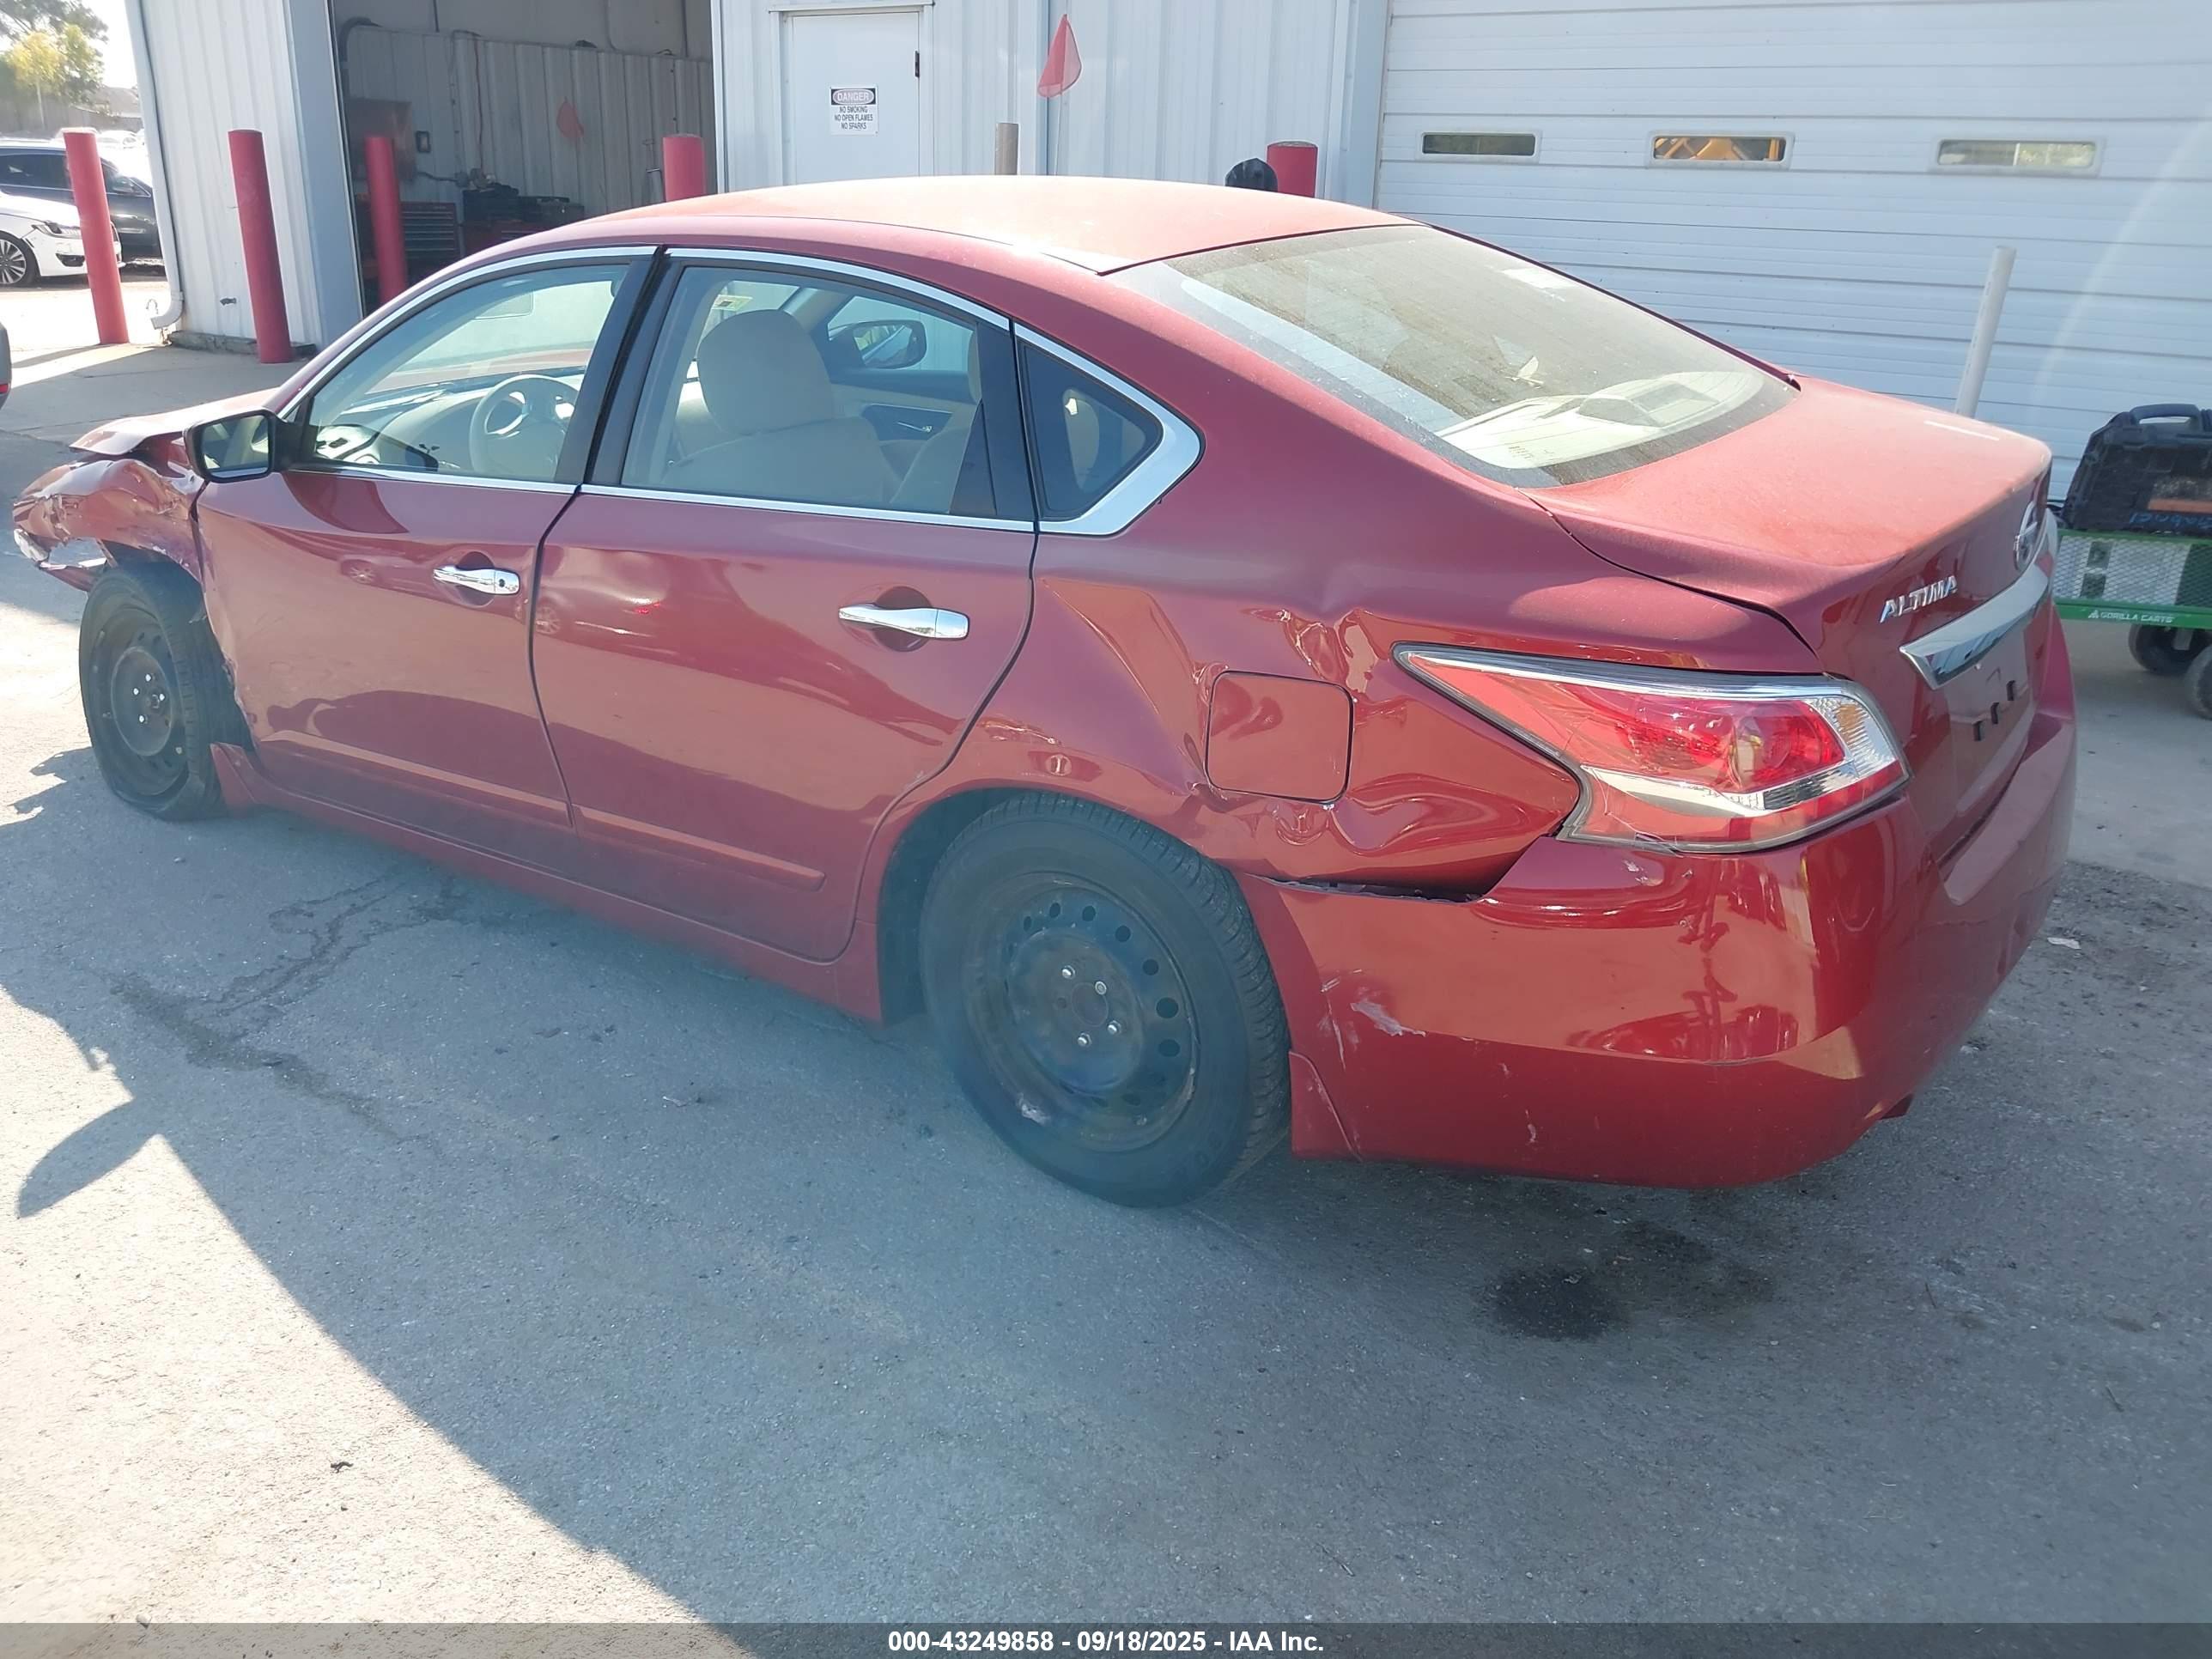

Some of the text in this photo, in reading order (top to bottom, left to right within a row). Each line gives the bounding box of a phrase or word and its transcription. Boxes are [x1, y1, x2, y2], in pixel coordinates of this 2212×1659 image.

[837, 92, 869, 101] DANGER
[1880, 575, 1958, 623] ALTIMA
[2100, 611, 2174, 623] GORILLA CARTS
